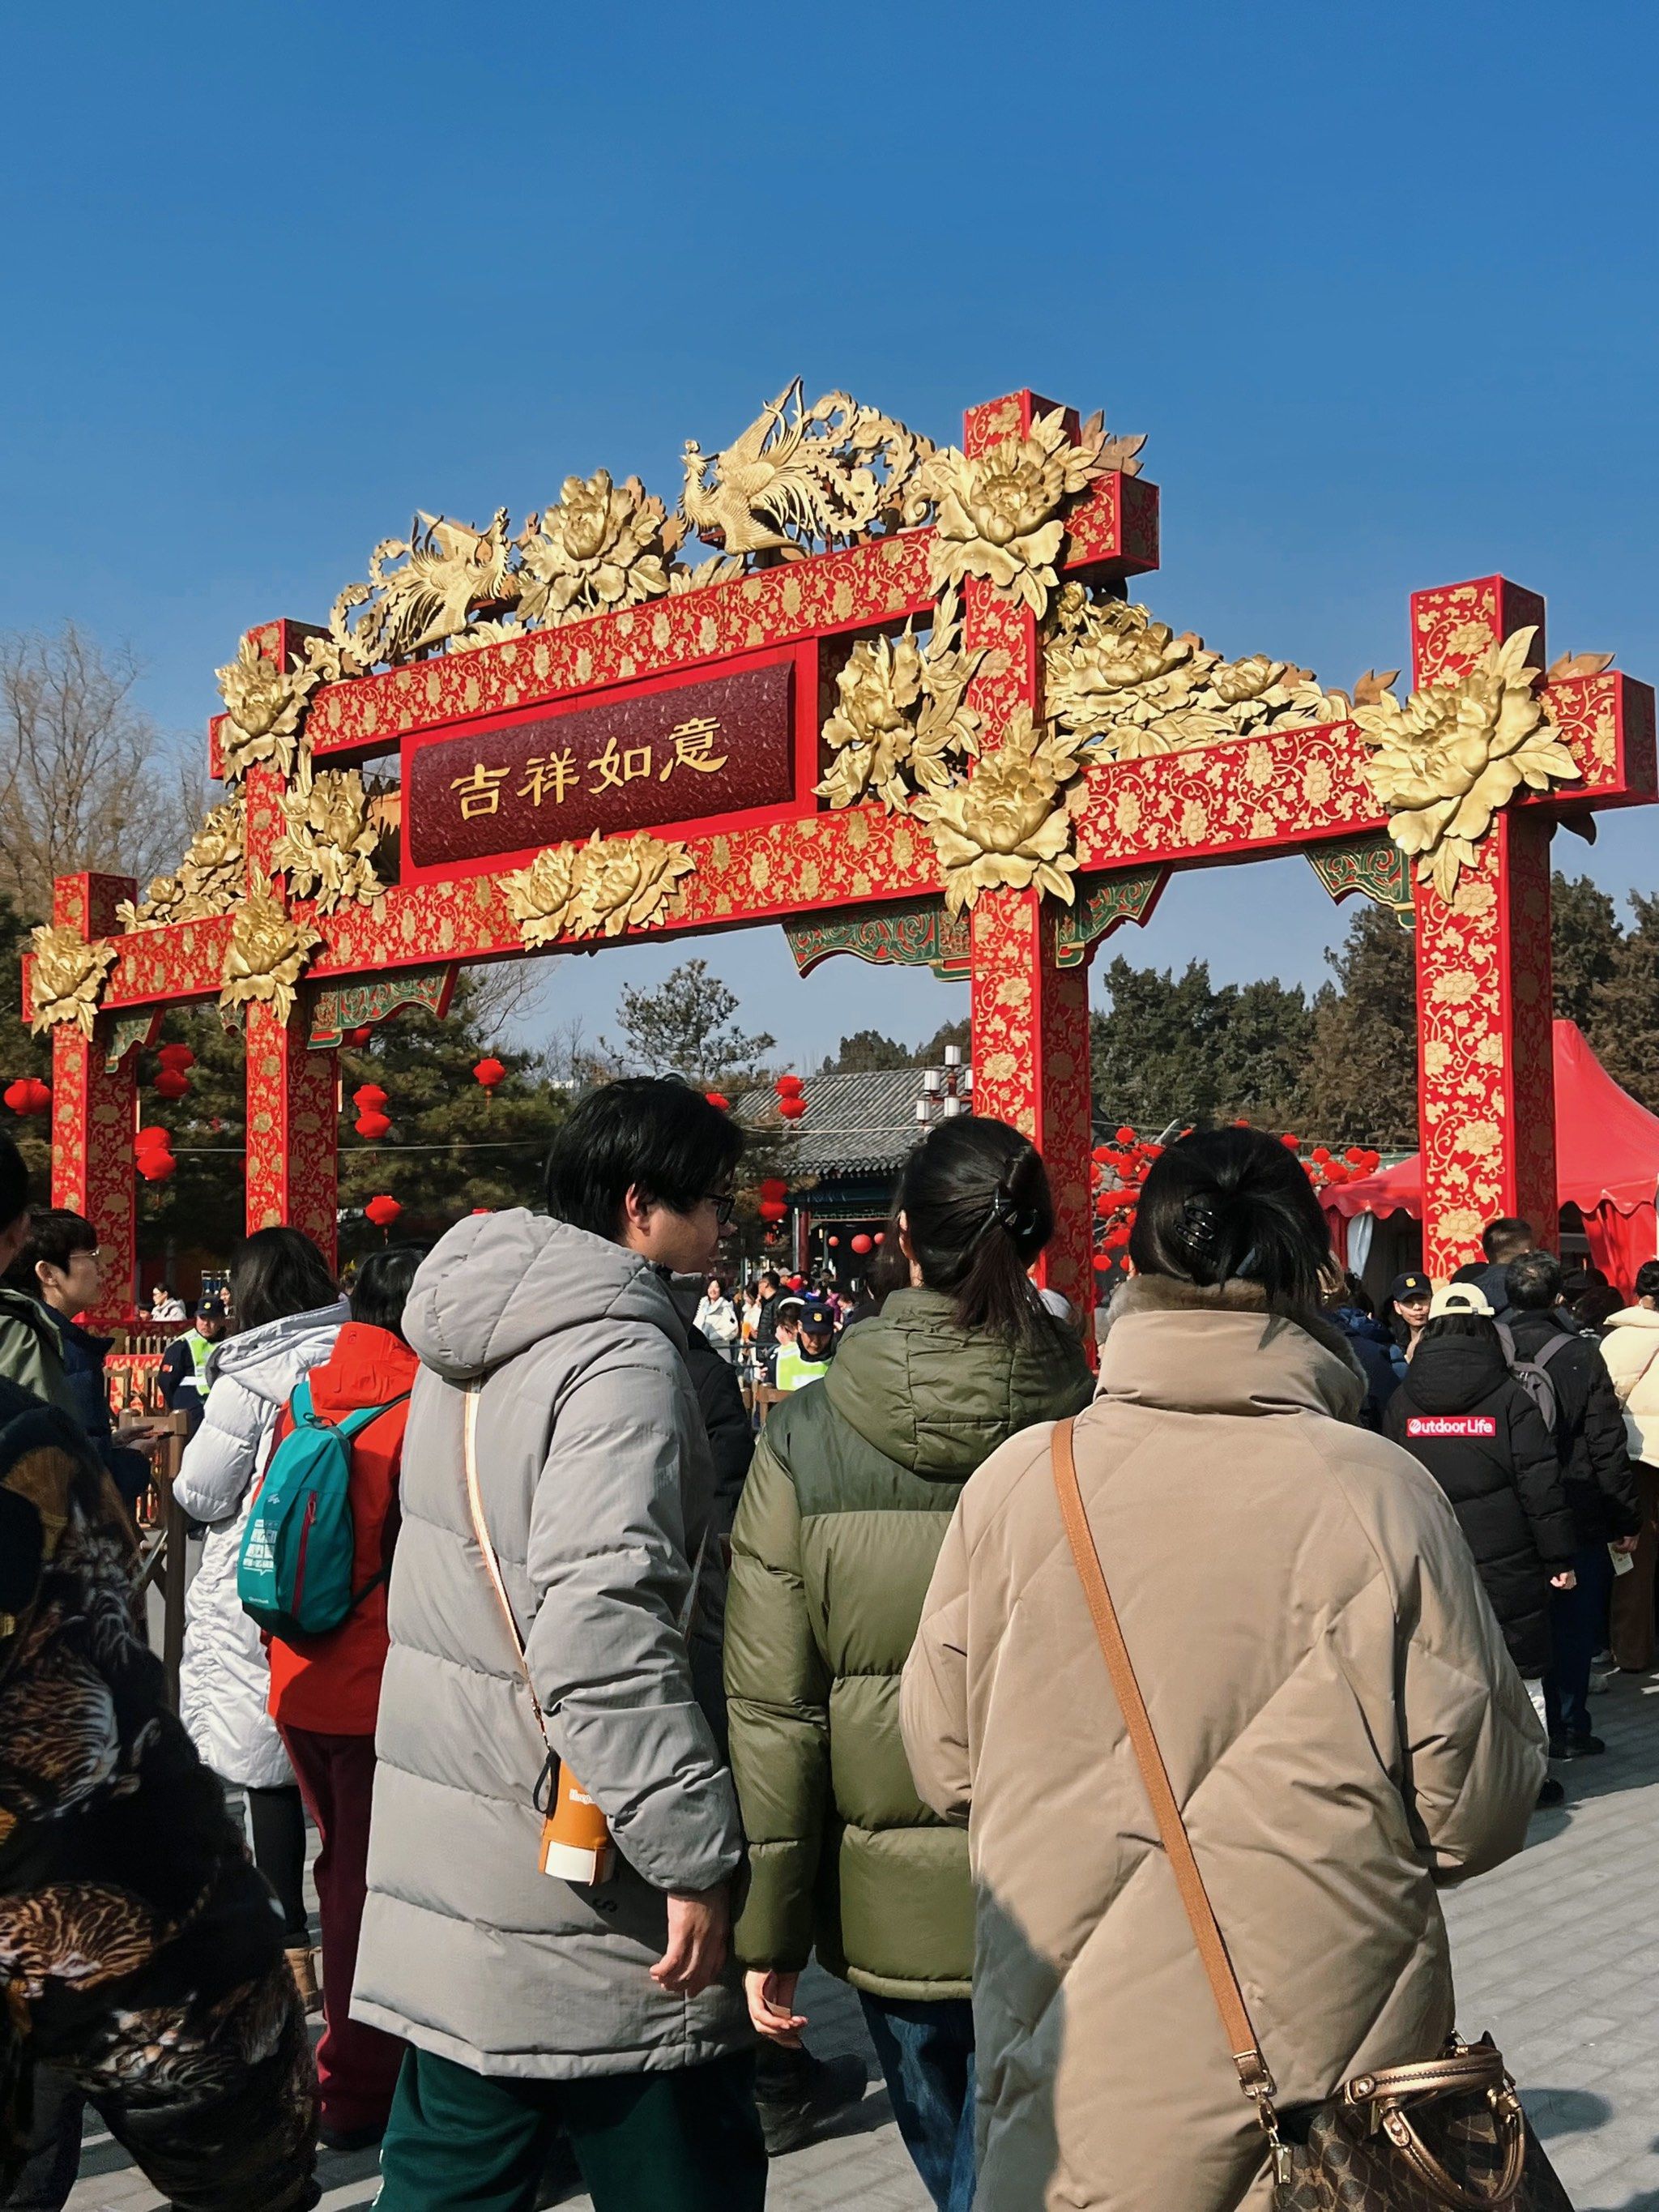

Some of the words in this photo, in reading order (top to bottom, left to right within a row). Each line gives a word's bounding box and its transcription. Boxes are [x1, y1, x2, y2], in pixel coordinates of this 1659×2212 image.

[450, 716, 728, 821] 吉祥如意
[1409, 1418, 1466, 1434] Outdoor
[1467, 1418, 1493, 1433] Life
